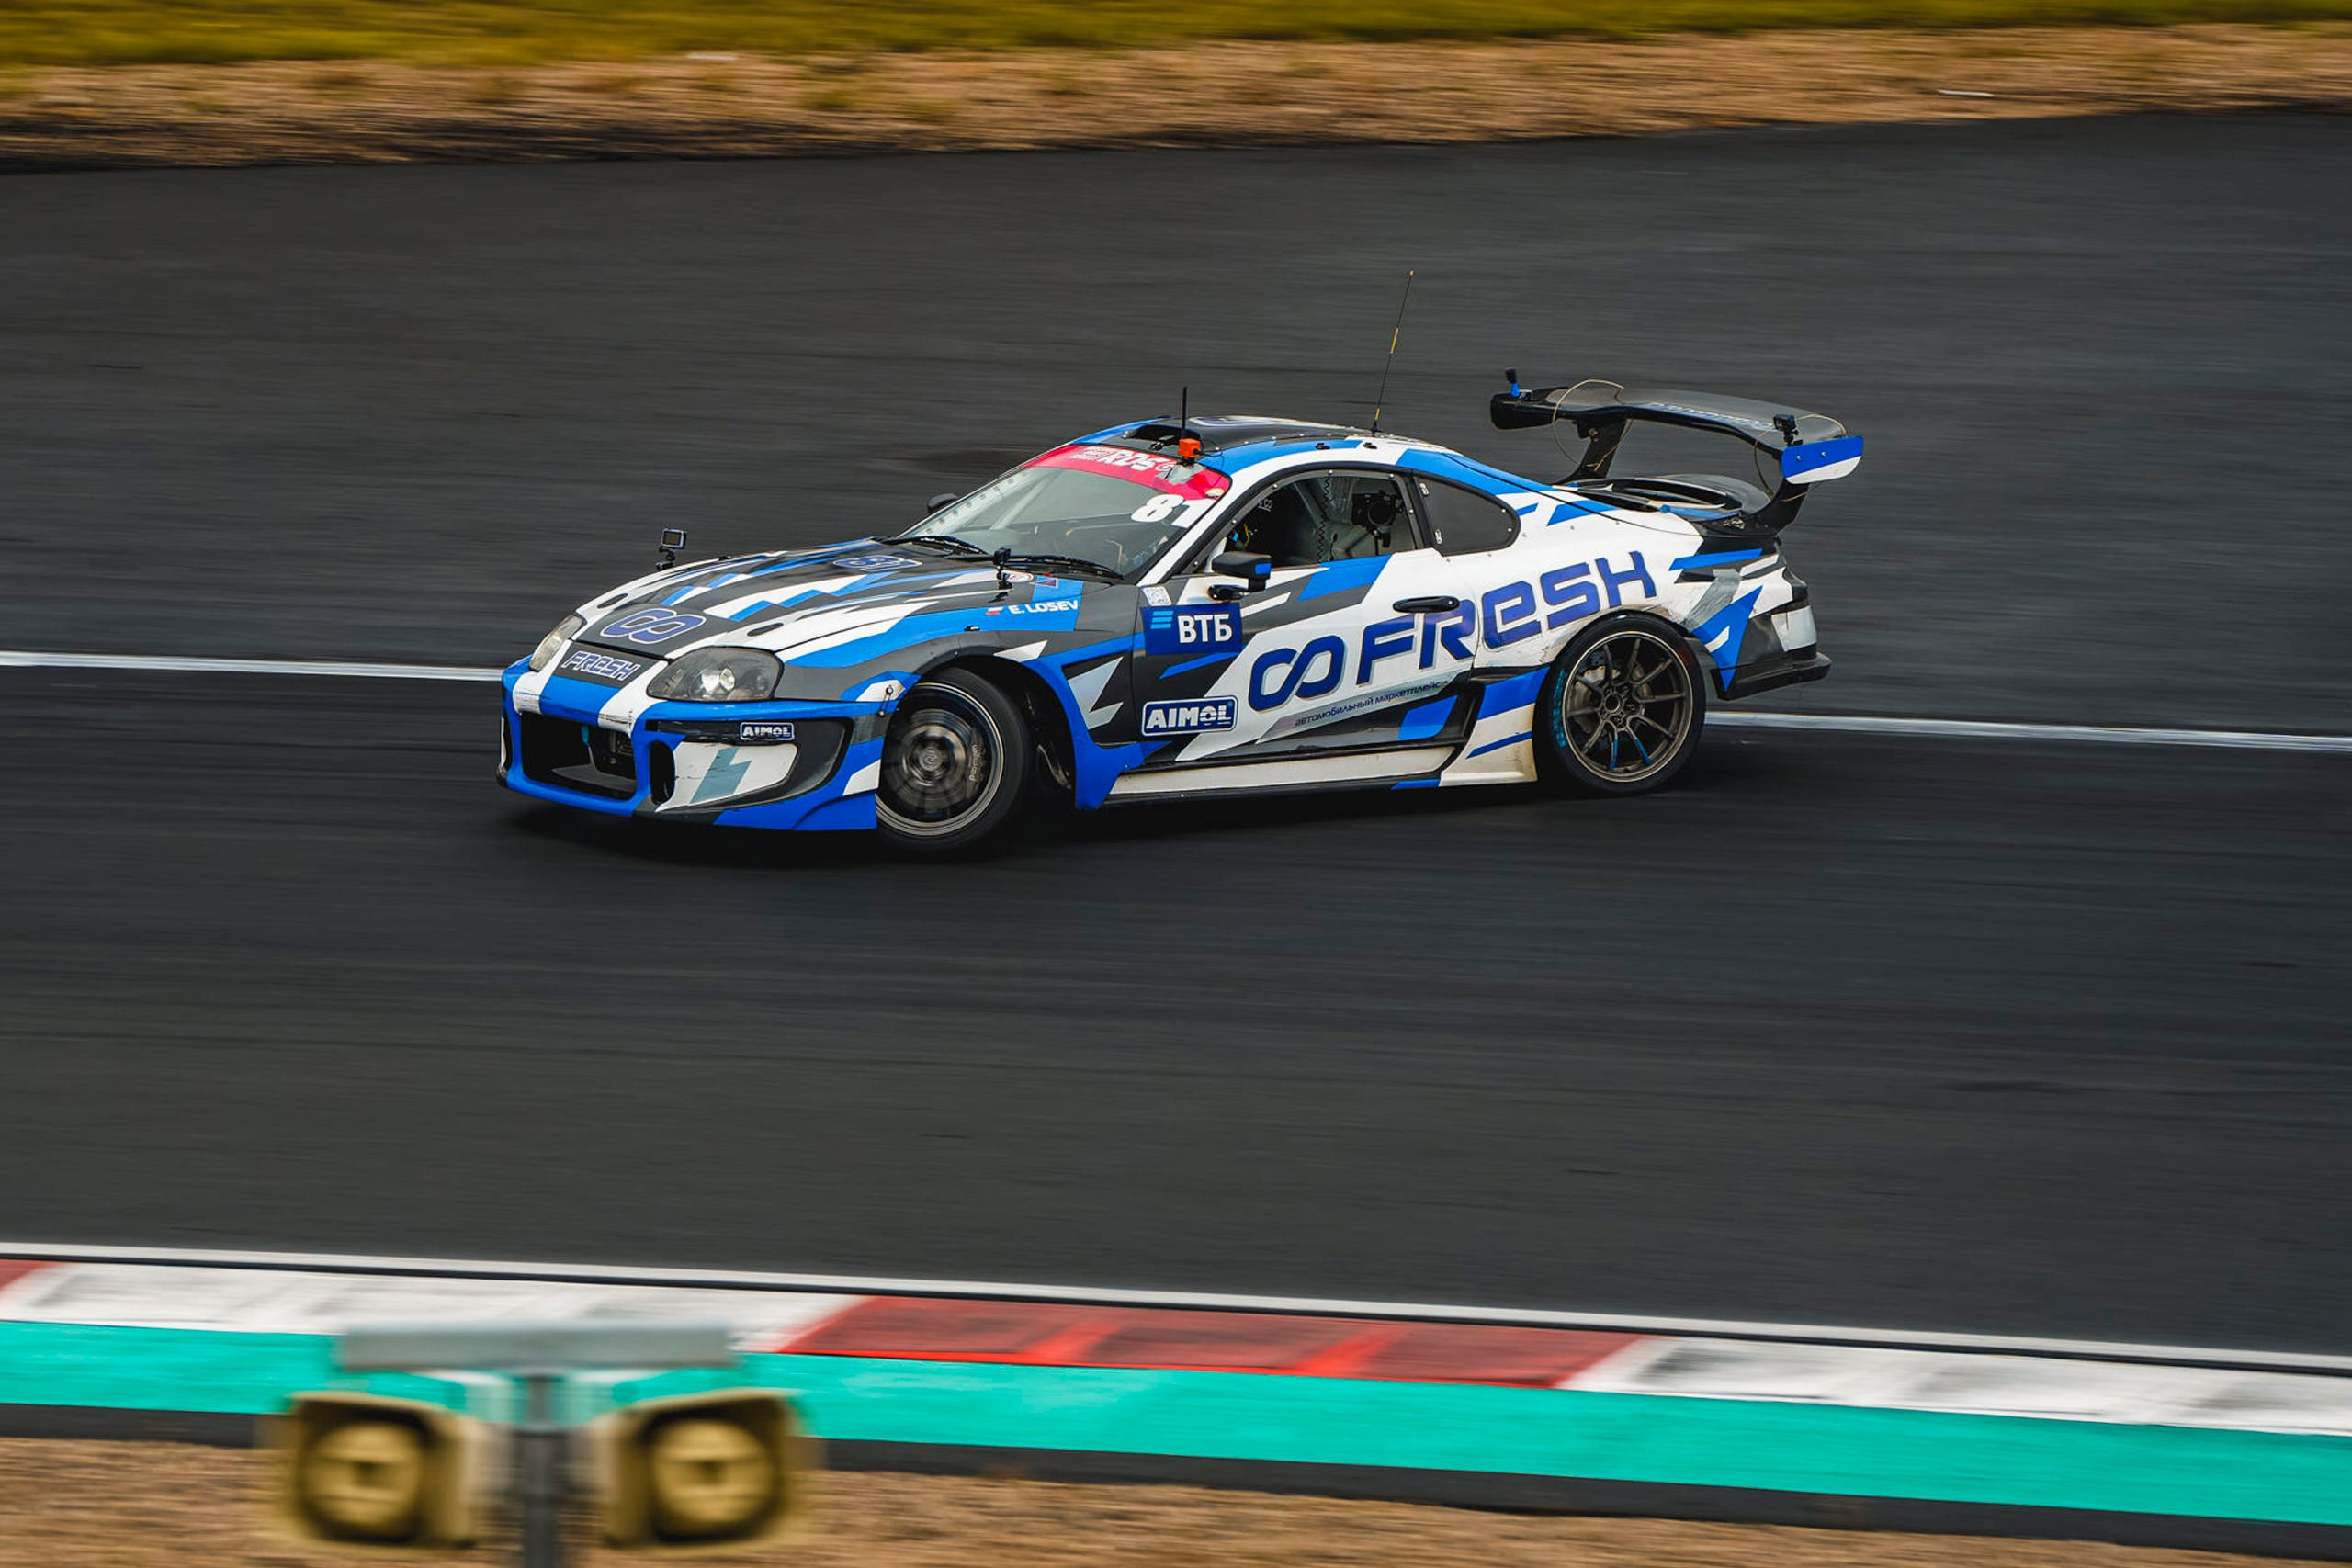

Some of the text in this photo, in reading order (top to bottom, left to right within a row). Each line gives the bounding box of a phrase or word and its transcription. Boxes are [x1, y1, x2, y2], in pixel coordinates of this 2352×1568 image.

[1096, 449, 1171, 471] RDS
[1131, 494, 1216, 528] 81
[1008, 600, 1079, 615] E. LOSEV
[1177, 614, 1233, 644] ВТБ
[1295, 681, 1442, 727] автомобильный маркетплейс
[1146, 705, 1232, 728] AIMOL
[742, 726, 791, 737] AIMOL
